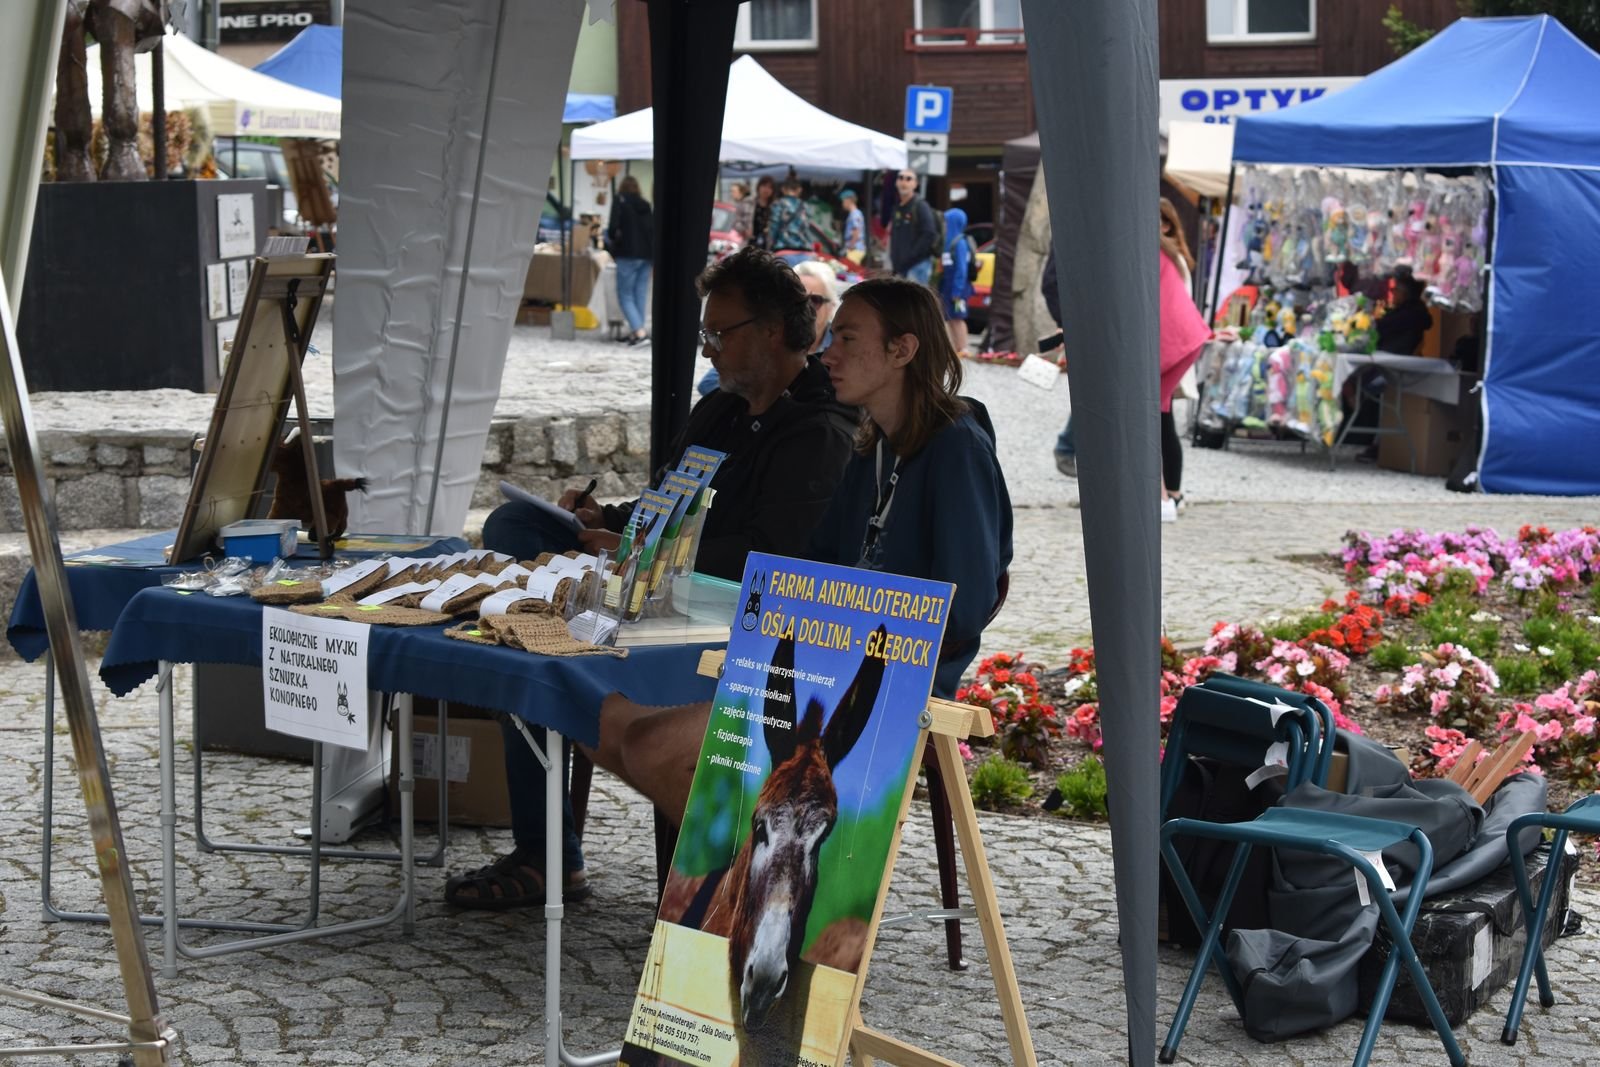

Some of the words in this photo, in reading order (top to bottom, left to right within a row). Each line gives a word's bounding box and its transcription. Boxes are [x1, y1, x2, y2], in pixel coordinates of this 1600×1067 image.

[260, 12, 313, 27] PRO
[915, 90, 943, 127] P
[769, 571, 815, 602] FARMA
[816, 579, 945, 624] ANIMALOTERAPII
[269, 625, 318, 650] EKOLOGICZNE
[325, 637, 358, 657] MYJKI
[760, 604, 796, 641] OŚLA
[797, 617, 853, 652] DOLINA
[865, 630, 933, 667] GŁĘBOCK
[268, 646, 275, 661] Z
[280, 649, 338, 675] NATURALNEGO
[735, 656, 755, 669] relaks
[756, 662, 761, 670] w
[763, 662, 806, 680] towarzystwie
[806, 672, 836, 689] zwierząt
[269, 667, 308, 690] SZNURKA
[269, 687, 318, 711] KONOPNEGO
[729, 681, 754, 697] spacery
[755, 688, 759, 696] z
[760, 688, 792, 703] osiołkami
[723, 706, 746, 719] zajęcia
[746, 710, 792, 730] terapeutyczne
[717, 728, 753, 747] fizjoterapia
[710, 753, 733, 768] pikniki
[733, 761, 762, 776] rodzinne
[637, 1016, 649, 1027] Tel.:
[653, 1023, 664, 1033] +48
[675, 1030, 687, 1040] 510
[640, 1004, 657, 1018] Farma
[657, 1010, 697, 1029] Animaloterapii
[633, 1028, 653, 1042] E-mail:
